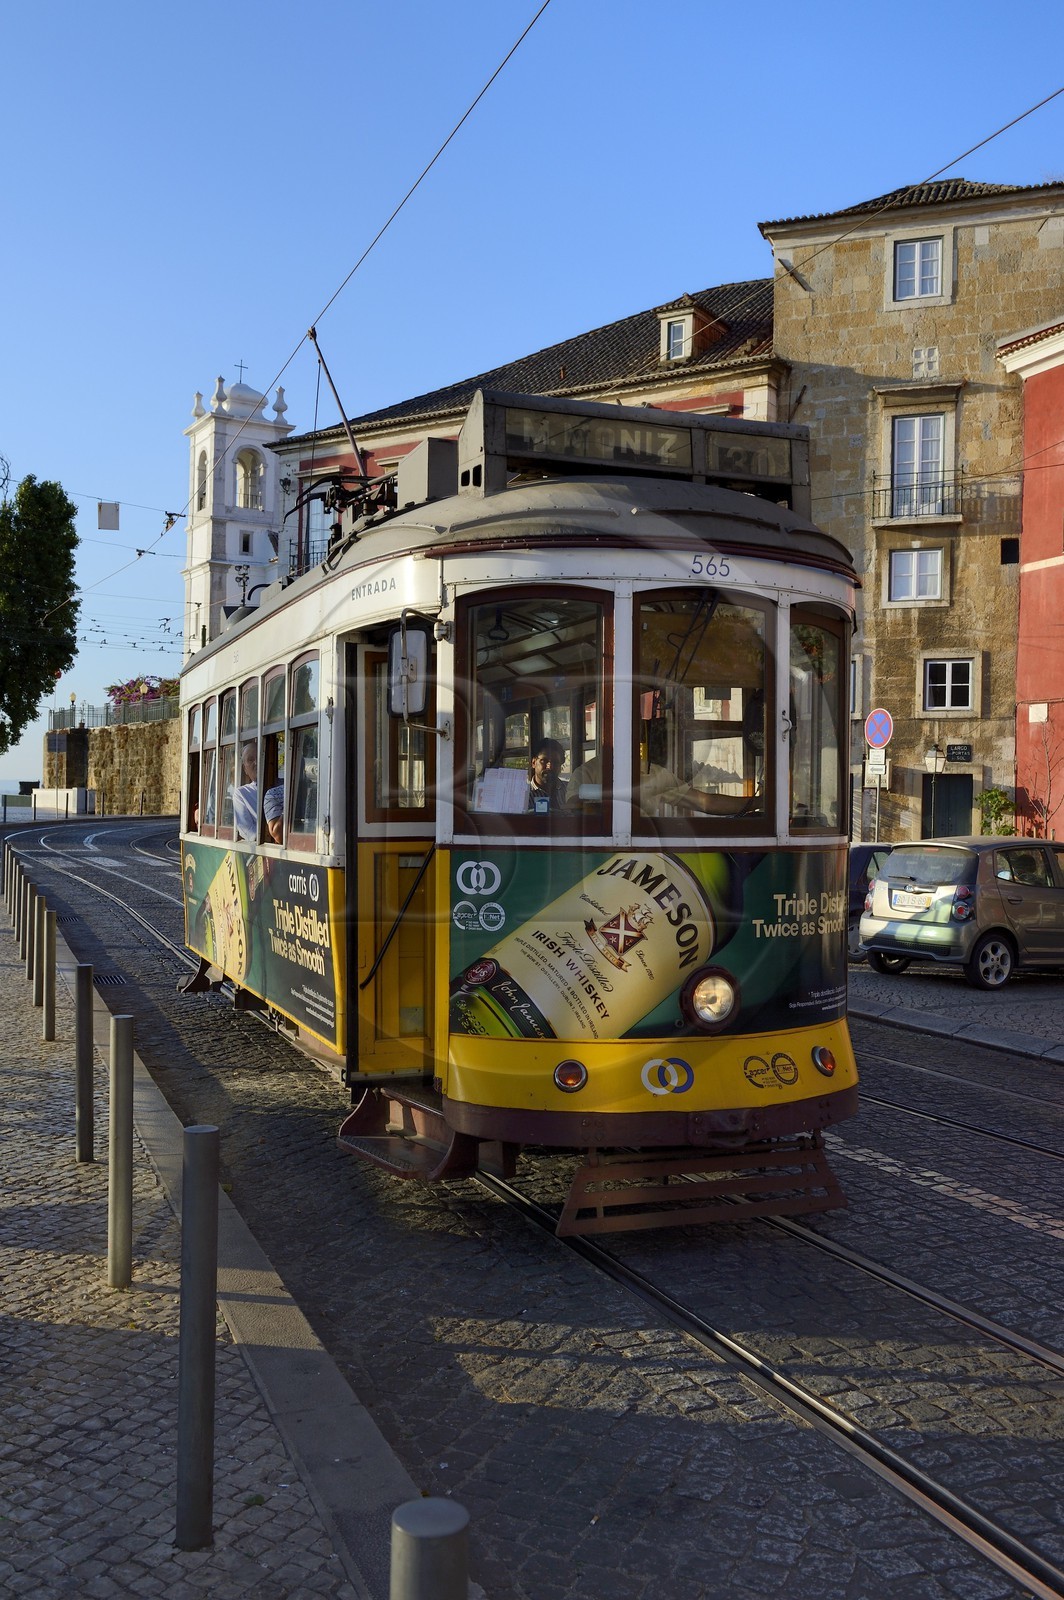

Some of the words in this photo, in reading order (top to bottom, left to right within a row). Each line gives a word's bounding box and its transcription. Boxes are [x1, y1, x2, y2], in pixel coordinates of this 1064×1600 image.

[563, 420, 679, 460] MONIZ
[691, 554, 731, 577] 565
[351, 577, 397, 602] ENTRADA
[288, 869, 307, 896] carris
[273, 899, 295, 940] Triple
[294, 905, 330, 949] Distilled
[596, 858, 700, 970] JAMESON
[773, 892, 818, 922] Triple
[268, 927, 289, 959] Twice
[288, 941, 297, 964] as
[752, 917, 799, 938] Twice
[801, 921, 816, 936] as
[531, 930, 566, 958] IRISH
[565, 958, 610, 1020] WHISKEY
[556, 931, 585, 957] Triple
[579, 953, 614, 993] Distilled
[491, 980, 519, 1004] John
[547, 962, 569, 987] MATURED
[570, 990, 588, 1014] BOTTLED
[587, 1019, 599, 1039] IRELAND
